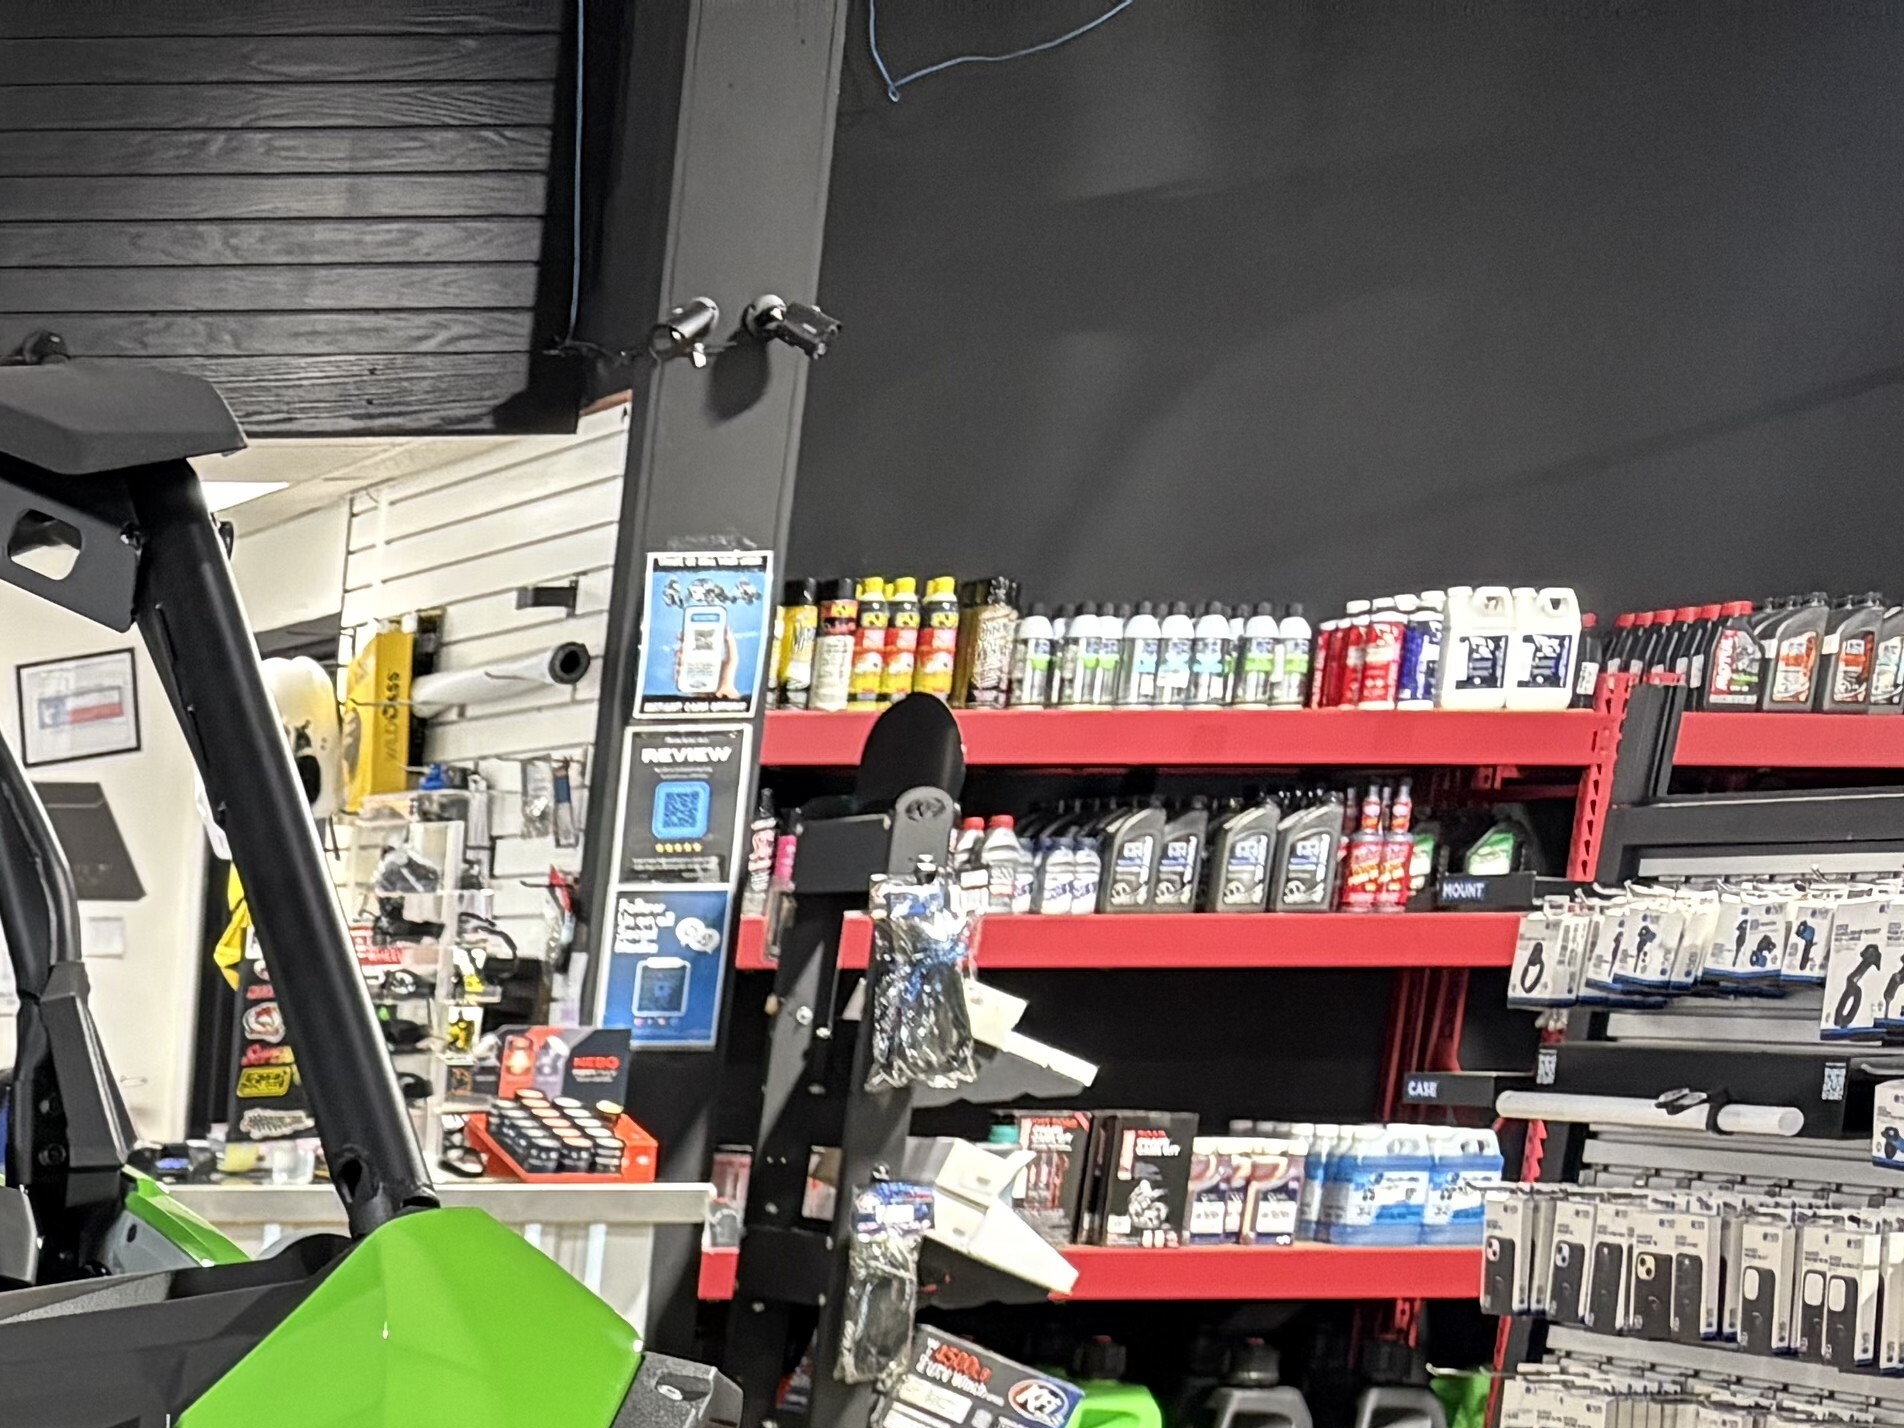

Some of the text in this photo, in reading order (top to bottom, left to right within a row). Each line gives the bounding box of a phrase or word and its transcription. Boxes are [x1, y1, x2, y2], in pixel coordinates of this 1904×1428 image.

[640, 746, 733, 764] REVIEW
[1443, 882, 1485, 899] MOUNT
[1407, 1080, 1438, 1098] CASE
